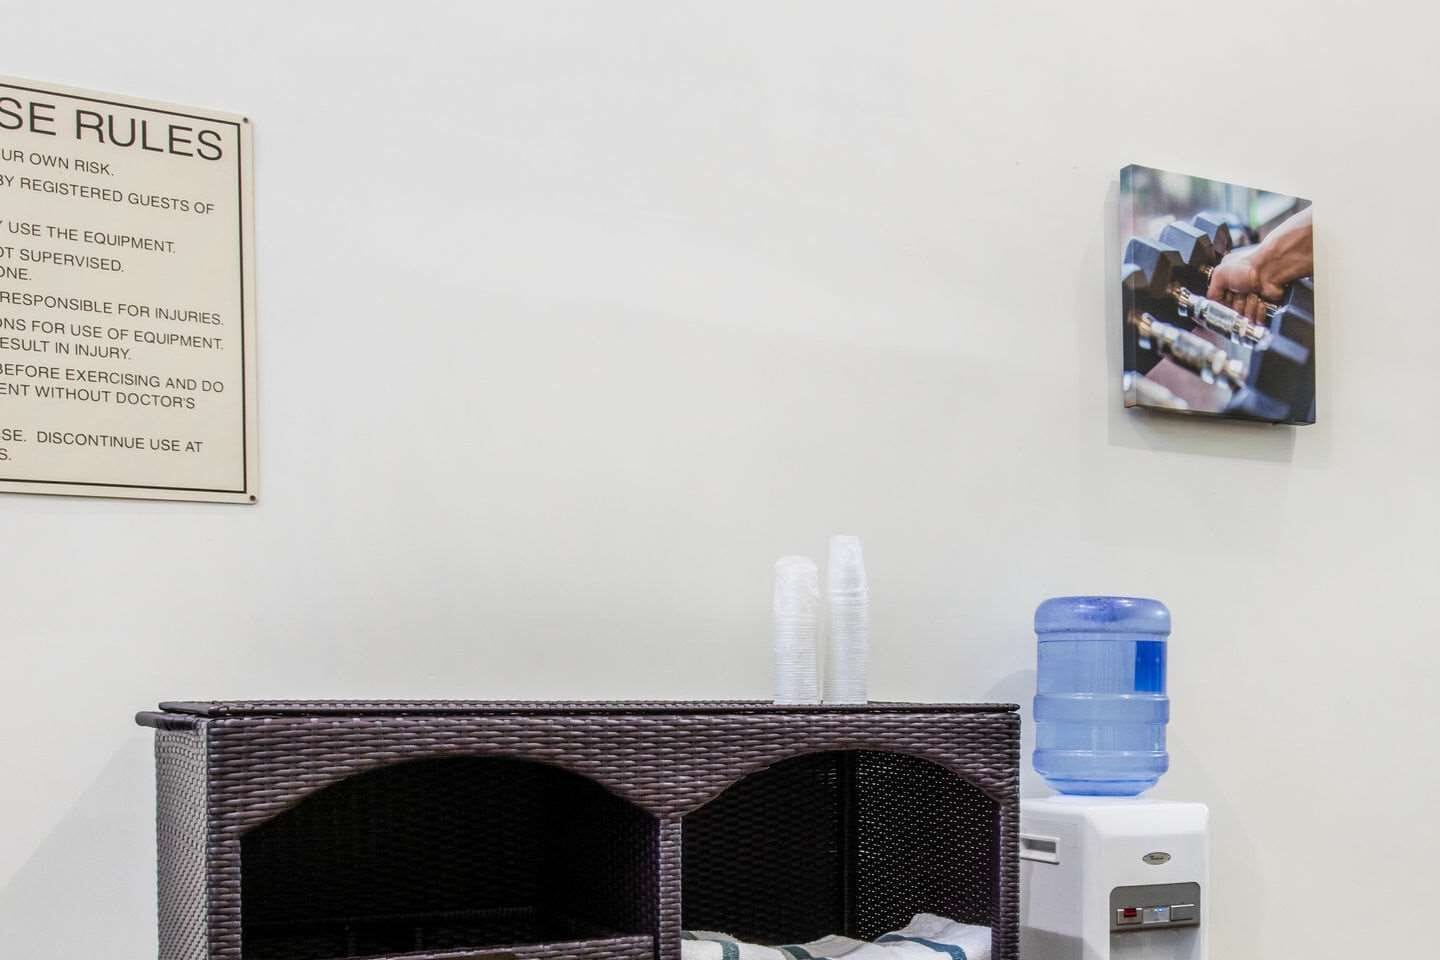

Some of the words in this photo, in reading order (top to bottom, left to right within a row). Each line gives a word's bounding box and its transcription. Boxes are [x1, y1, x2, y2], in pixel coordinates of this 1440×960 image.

[0, 97, 56, 135] SE
[76, 109, 223, 161] RULES
[29, 153, 69, 169] OWN
[74, 159, 114, 176] RISK.
[20, 177, 123, 202] REGISTERED
[128, 192, 190, 212] GUESTS
[194, 202, 215, 214] OF
[8, 221, 41, 236] USE
[47, 226, 78, 240] THE
[84, 231, 176, 254] EQUIPMENT.
[19, 249, 124, 272] SUPERVISED.
[0, 291, 113, 314] RESPONSIBLE
[118, 304, 150, 317] FOR
[155, 308, 224, 325] INJURIES.
[0, 318, 26, 330] NS
[31, 320, 65, 335] FOR
[71, 324, 102, 338] USE
[107, 327, 129, 340] OF
[134, 331, 224, 350] EQUIPMENT.
[0, 337, 50, 352] ESULT
[55, 342, 70, 354] IN
[75, 344, 132, 360] INJURY.
[65, 369, 160, 388] EXERCISING
[166, 377, 197, 391] AND
[202, 380, 224, 393] DO
[35, 385, 112, 403] WITHOUT
[116, 391, 196, 409] DOCTOR'S
[37, 431, 145, 450] DISCONTINUE
[149, 439, 181, 451] USE
[185, 441, 204, 452] AT
